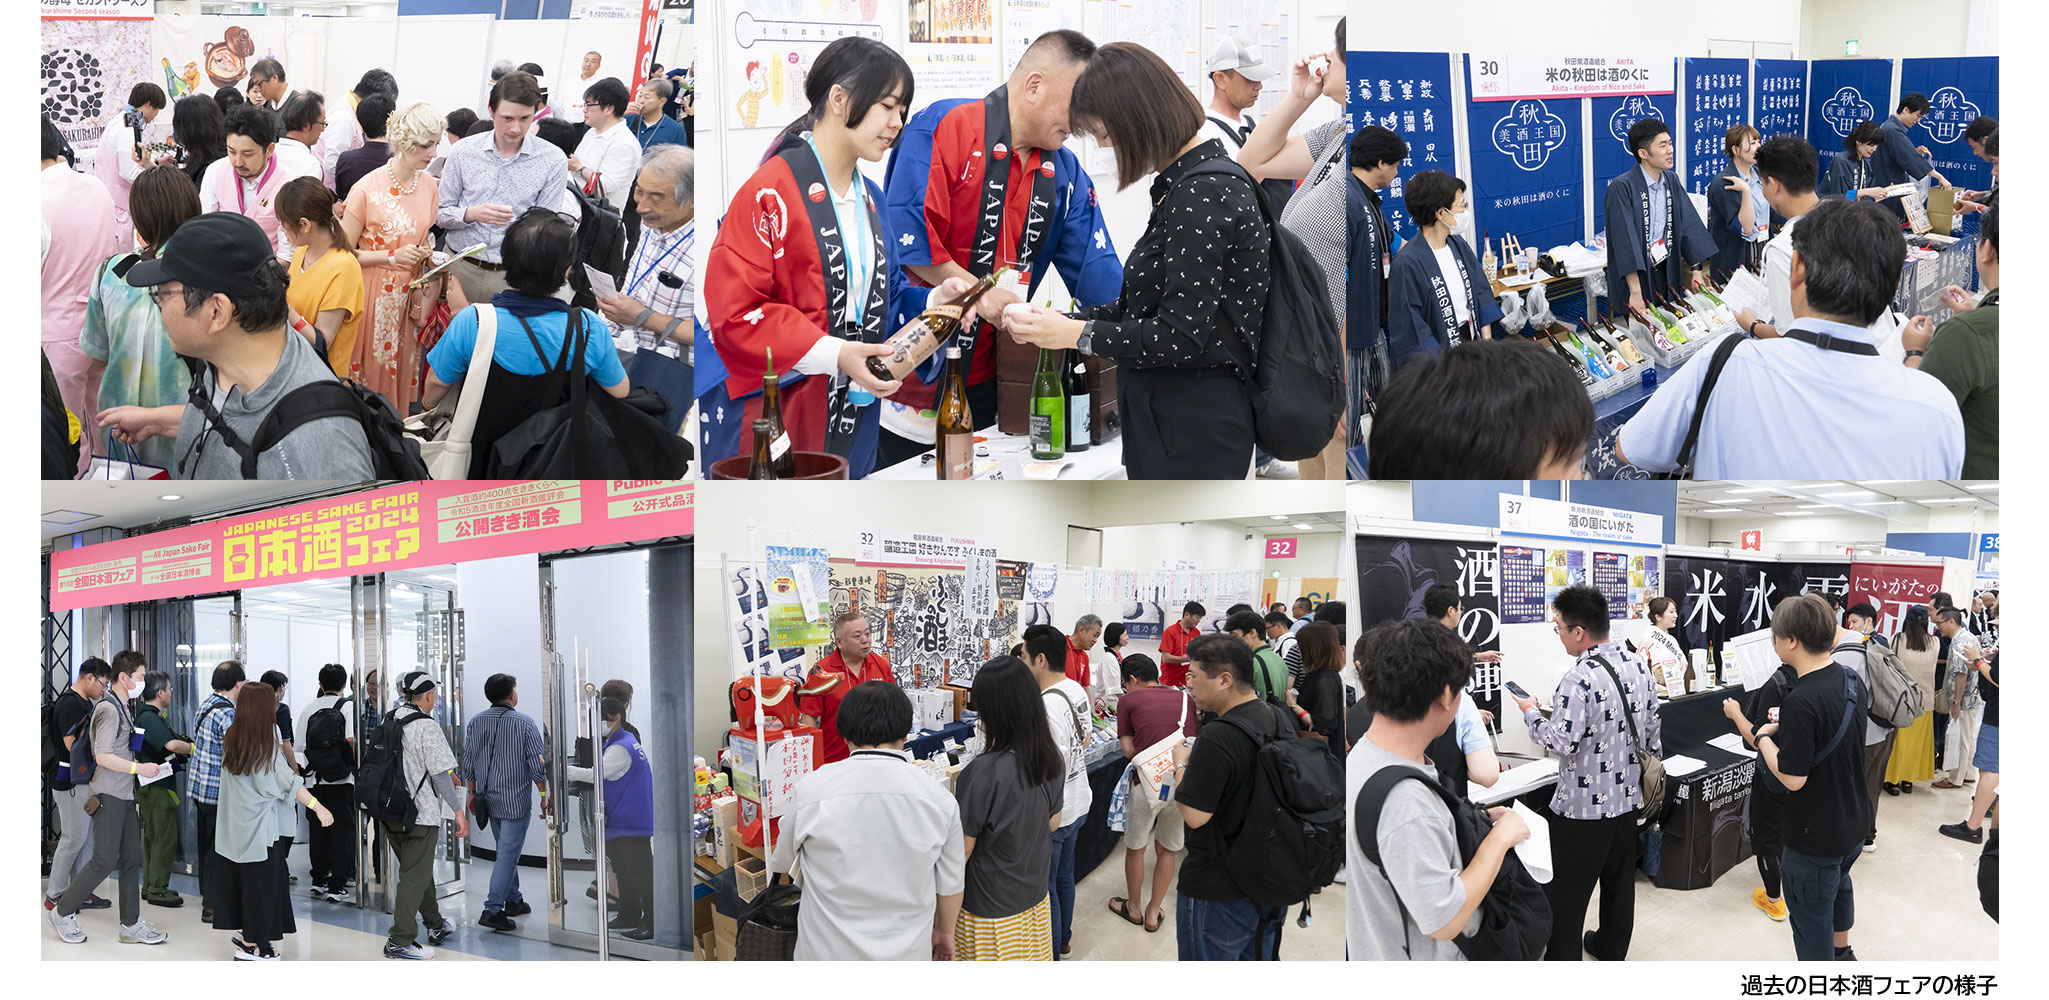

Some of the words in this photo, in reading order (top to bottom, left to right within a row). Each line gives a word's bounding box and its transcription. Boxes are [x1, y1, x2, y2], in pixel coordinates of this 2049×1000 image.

[1480, 60, 1499, 76] 30
[1564, 57, 1606, 66] 秋田県酒造組合
[1545, 67, 1649, 83] 米の秋田は酒のくに
[1551, 84, 1568, 92] Akita
[1574, 84, 1599, 93] Kingdom
[1609, 83, 1620, 91] Rice
[1629, 97, 1645, 116] 秋
[1840, 92, 1855, 107] 秋
[1938, 92, 1957, 109] 秋
[1519, 103, 1540, 125] 秋
[1499, 124, 1561, 143] 美酒王国
[1938, 122, 1955, 138] 田
[1523, 142, 1541, 164] 田
[1494, 188, 1570, 209] 米の秋田は酒のくに
[977, 180, 1005, 266] JAPAN
[820, 226, 846, 328] JAPAN
[865, 234, 887, 334] JAPAN
[223, 511, 313, 537] JAPANESE
[318, 501, 367, 521] SAKE
[372, 492, 420, 511] FAIR
[1507, 500, 1522, 514] 37
[1612, 511, 1633, 519] NIIGATA
[347, 507, 420, 534] 2024
[455, 507, 561, 538] 公開きき酒会
[1569, 514, 1634, 533] 酒の国にいがた
[861, 532, 874, 545] 32
[1570, 529, 1589, 537] Niigata
[153, 550, 161, 559] All
[162, 547, 180, 558] Japan
[181, 545, 197, 555] Sake
[198, 542, 210, 552] Fair
[223, 519, 420, 582] 日本酒フェア
[1271, 541, 1290, 555] 32
[915, 556, 933, 564] Brewing
[1854, 575, 1940, 597] にいがたの
[1684, 568, 1727, 633] 米
[1741, 570, 1777, 630] 水
[1651, 630, 1667, 644] 2024
[1665, 641, 1678, 656] Miss
